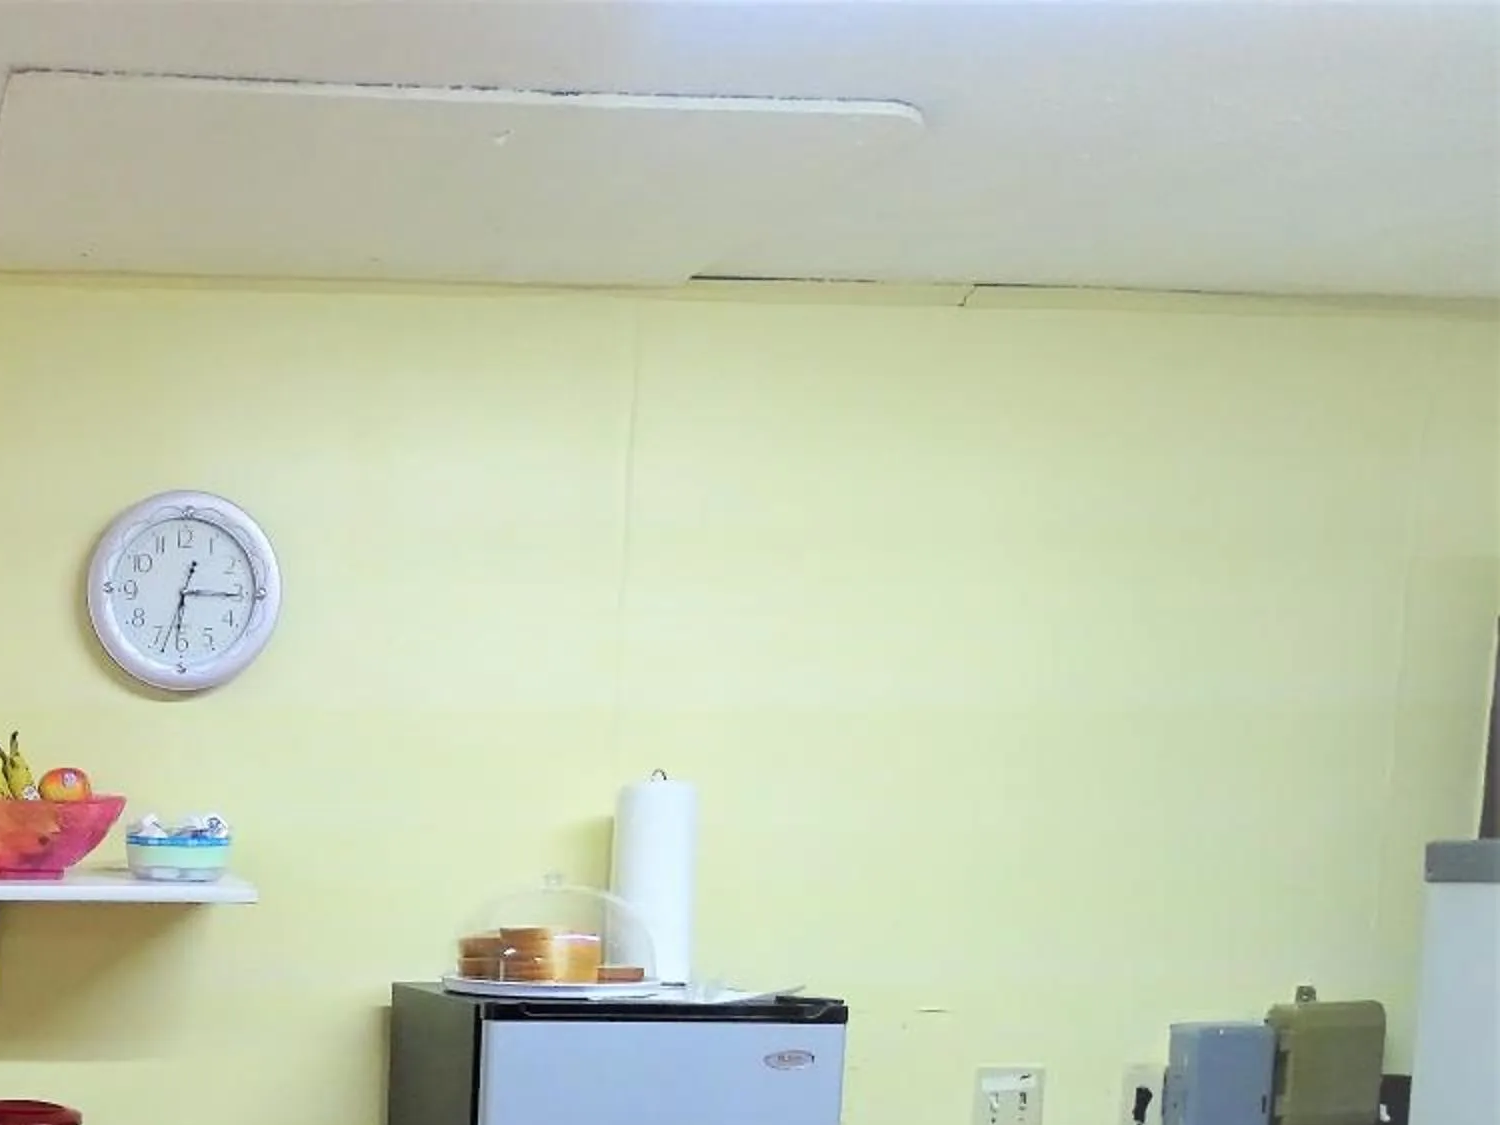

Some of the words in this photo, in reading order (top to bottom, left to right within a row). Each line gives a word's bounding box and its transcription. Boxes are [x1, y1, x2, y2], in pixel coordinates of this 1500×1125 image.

[155, 535, 166, 554] 11
[177, 528, 194, 549] 12
[132, 553, 154, 574] 10
[223, 556, 235, 575] 2
[123, 579, 139, 601] 9
[131, 607, 146, 628] 8
[221, 609, 234, 628] 4
[152, 625, 164, 646] 7
[203, 627, 214, 648] 5
